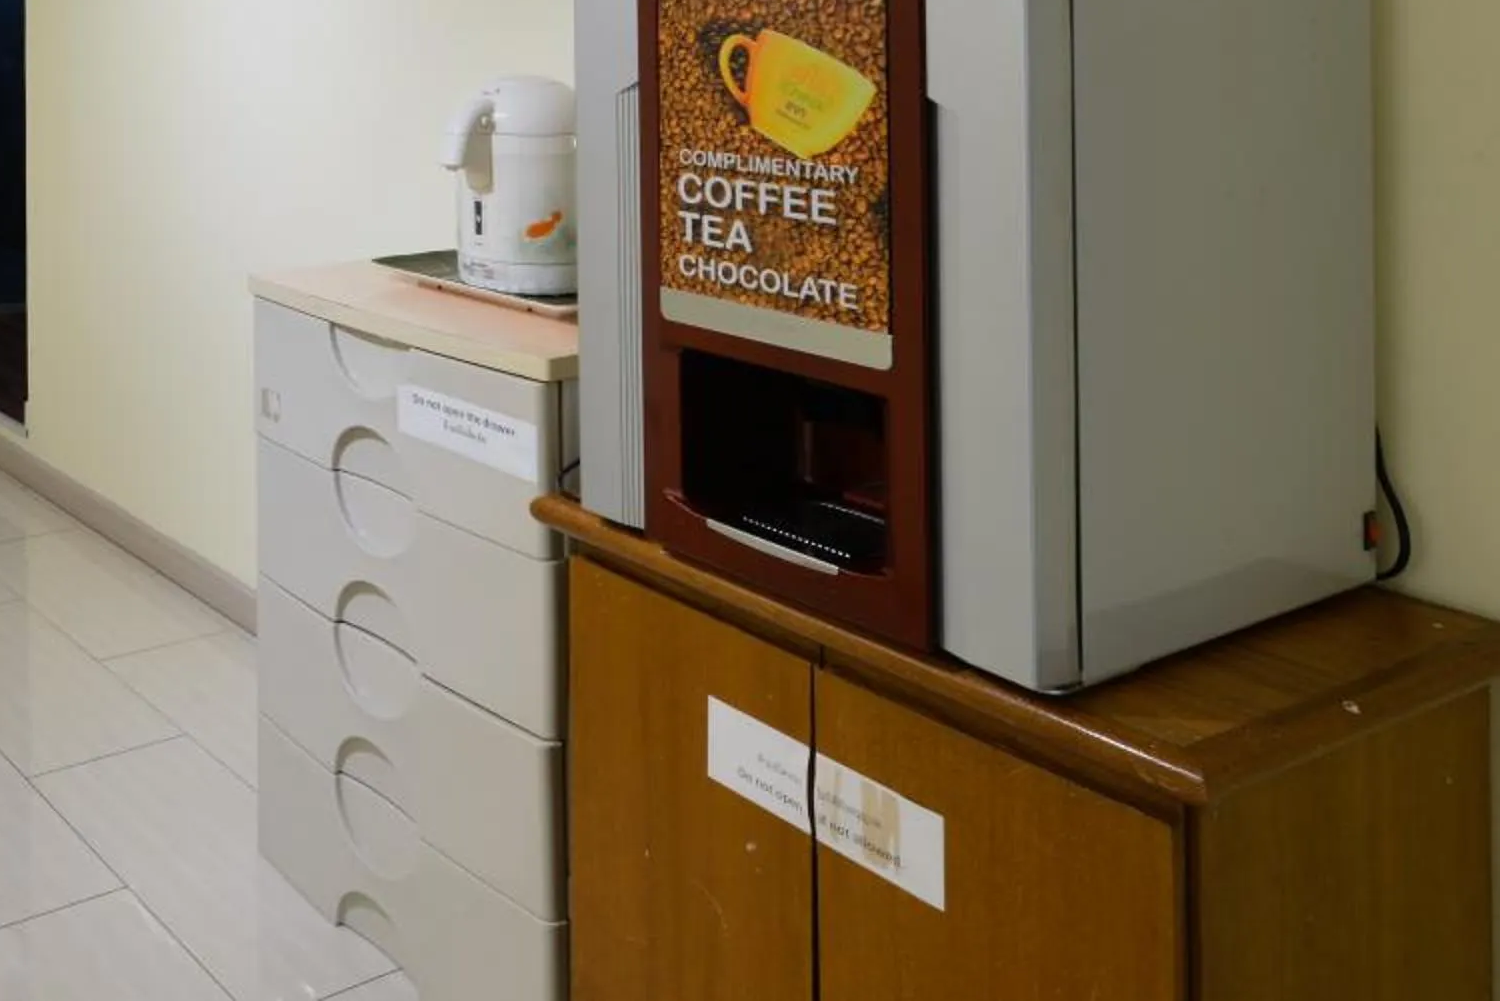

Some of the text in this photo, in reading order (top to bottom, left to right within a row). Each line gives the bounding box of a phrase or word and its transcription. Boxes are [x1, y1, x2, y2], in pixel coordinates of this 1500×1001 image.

[678, 148, 860, 184] COMPLIMENTARY
[678, 172, 838, 226] COFFEE
[678, 210, 753, 253] TEA
[679, 254, 860, 311] CHOCOLATE
